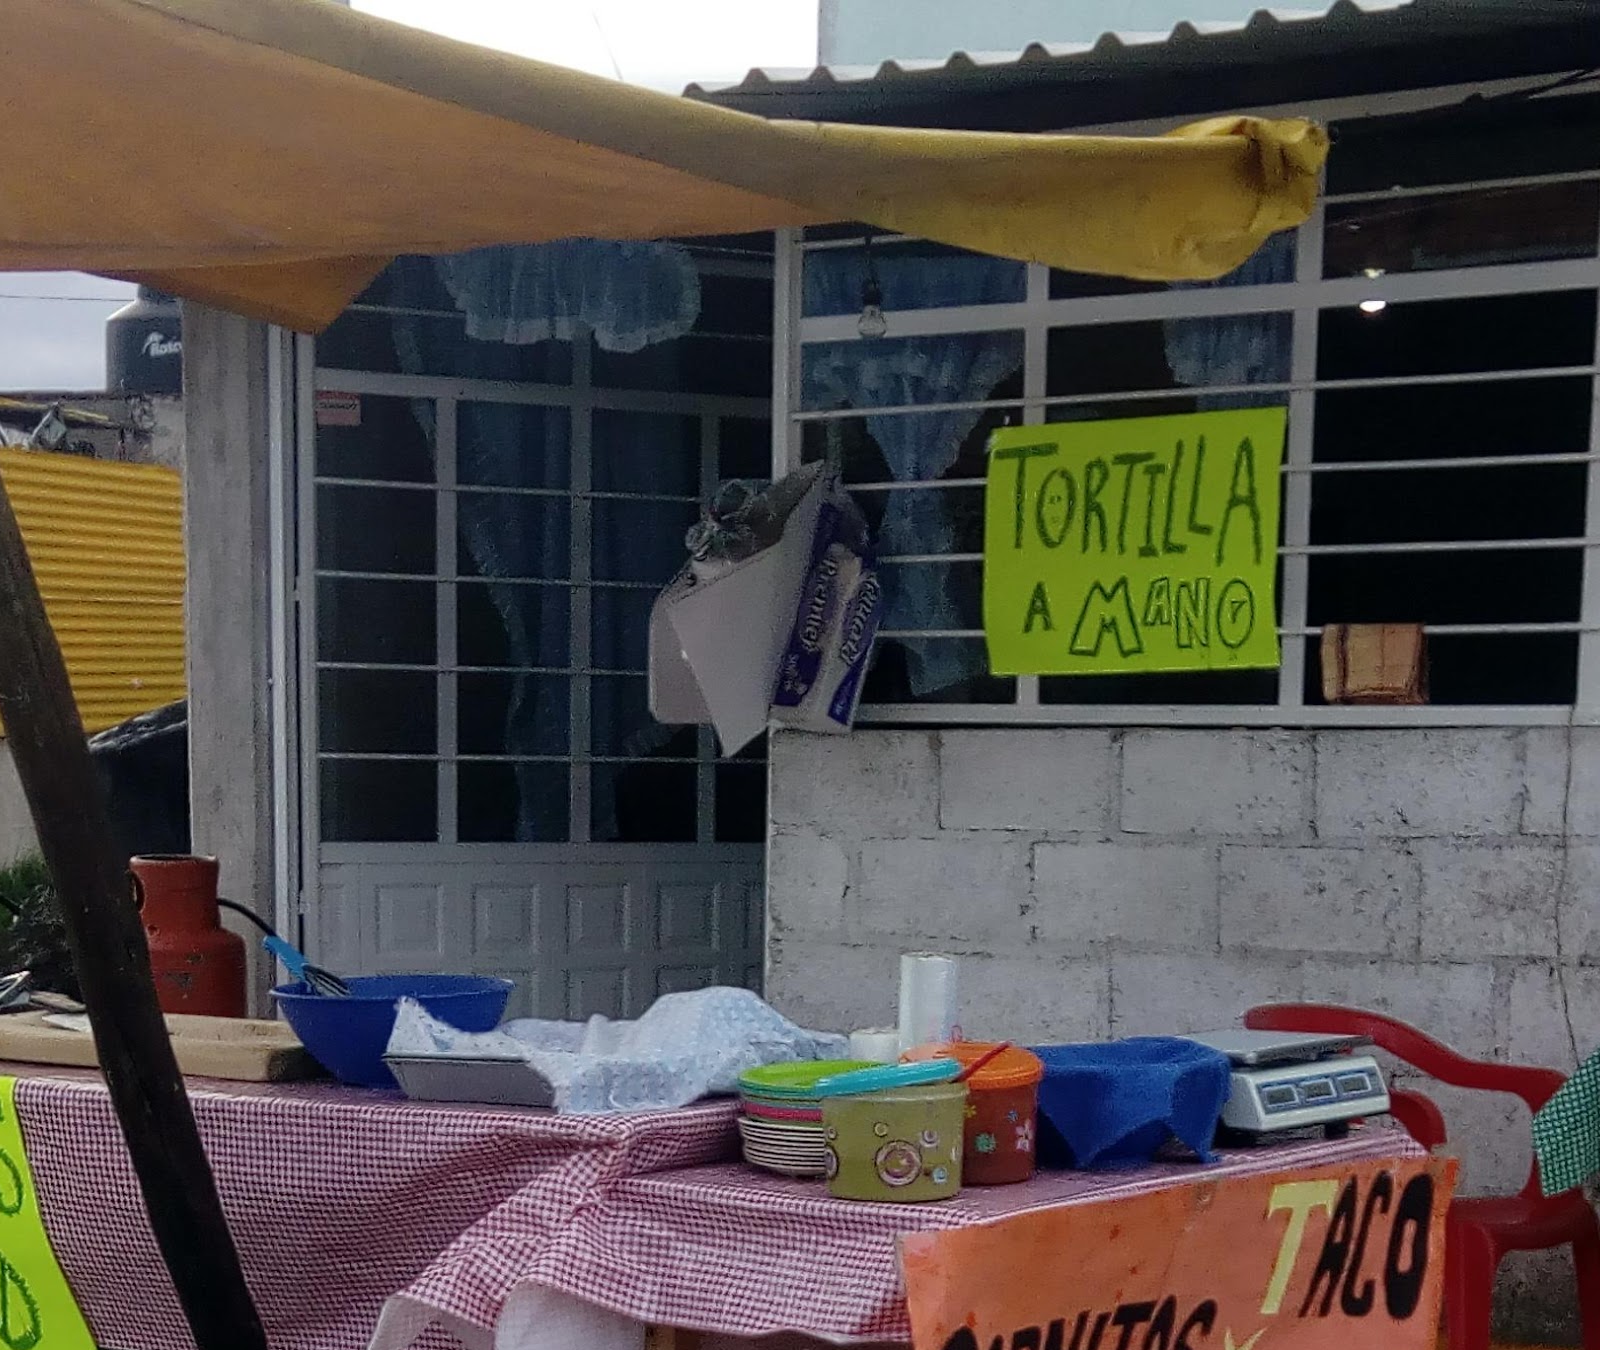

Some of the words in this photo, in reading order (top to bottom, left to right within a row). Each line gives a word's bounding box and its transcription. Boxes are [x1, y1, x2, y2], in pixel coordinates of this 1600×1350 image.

[994, 434, 1263, 567] TORTILLA
[1022, 580, 1055, 634] A
[1068, 575, 1256, 658] MANO
[1260, 1169, 1436, 1320] TACO
